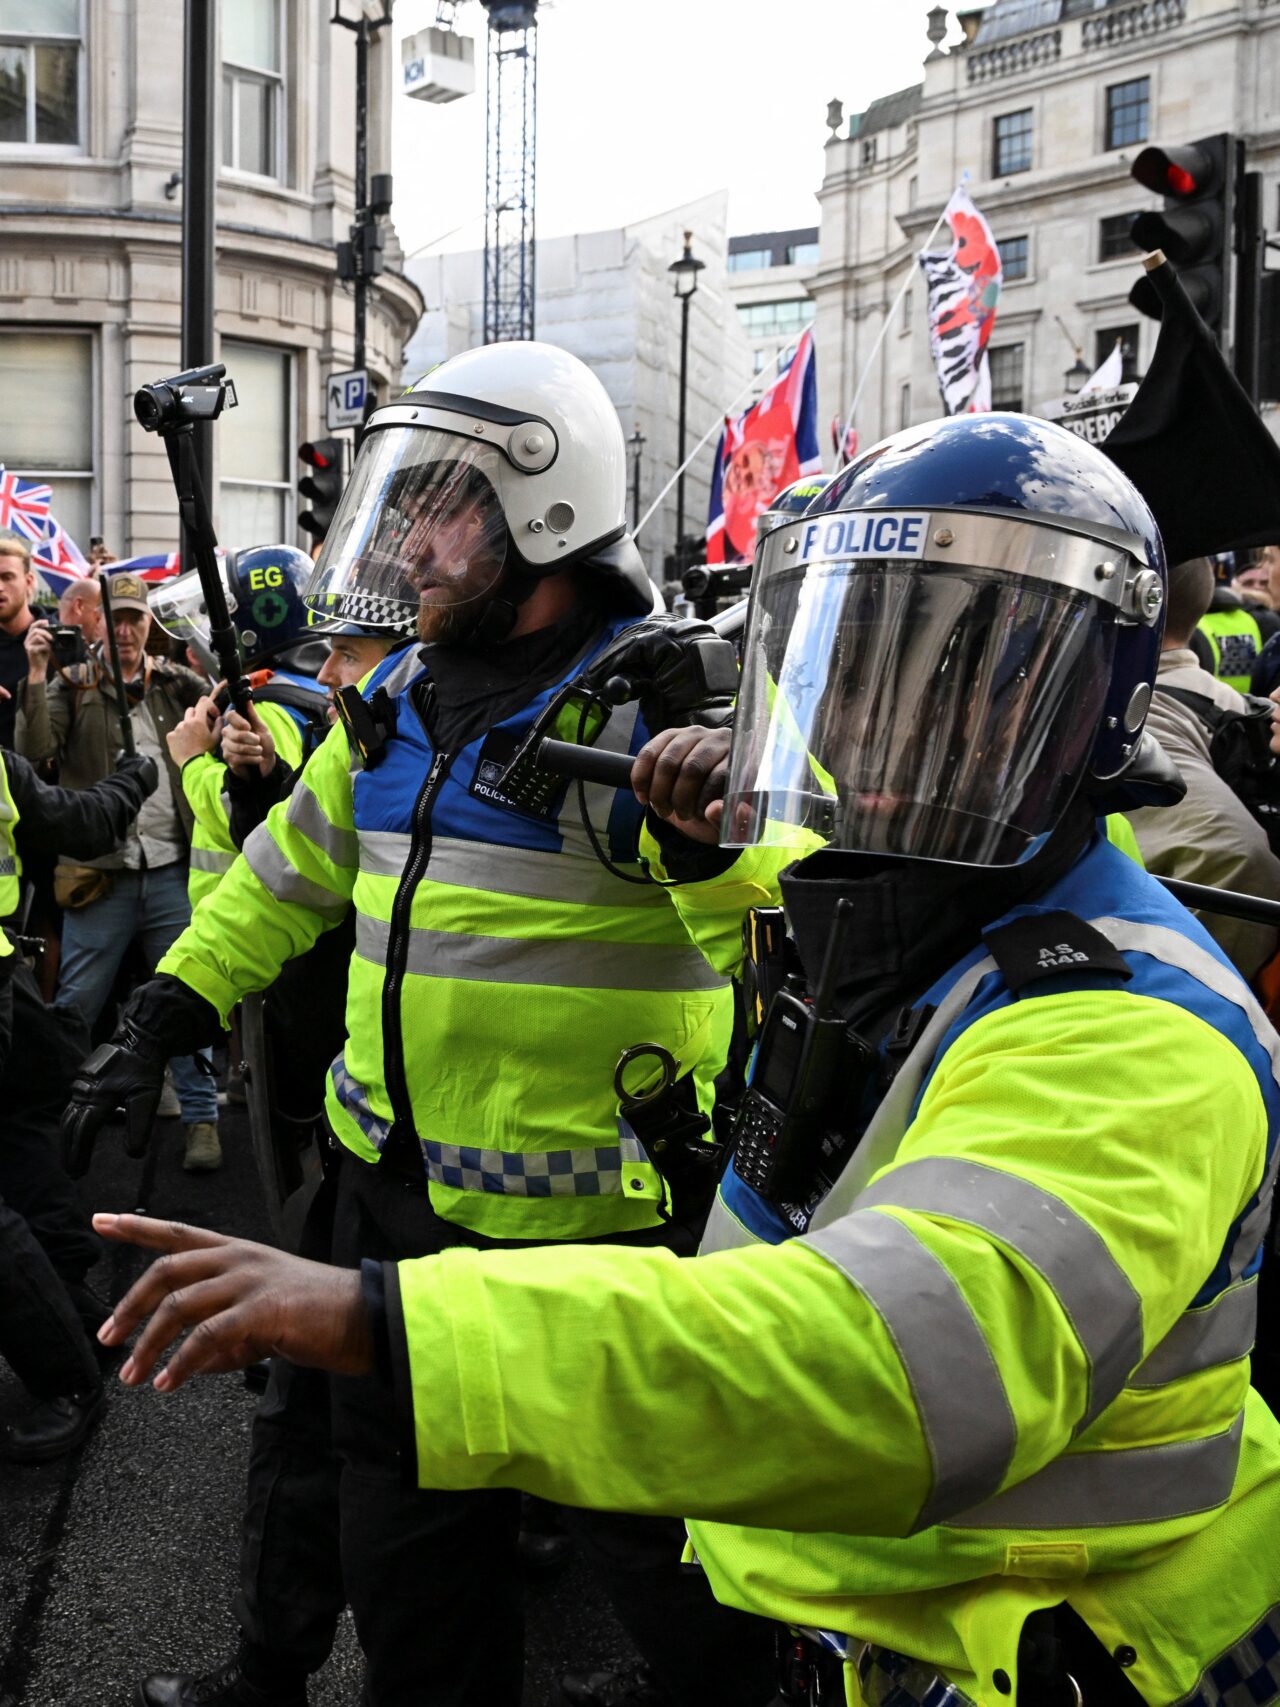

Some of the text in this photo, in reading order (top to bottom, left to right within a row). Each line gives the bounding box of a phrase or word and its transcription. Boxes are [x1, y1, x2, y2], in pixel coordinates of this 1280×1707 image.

[348, 381, 361, 408] P
[802, 517, 922, 559] POLICE
[250, 566, 283, 591] EG
[1037, 952, 1089, 967] 1148
[1040, 944, 1073, 959] AS
